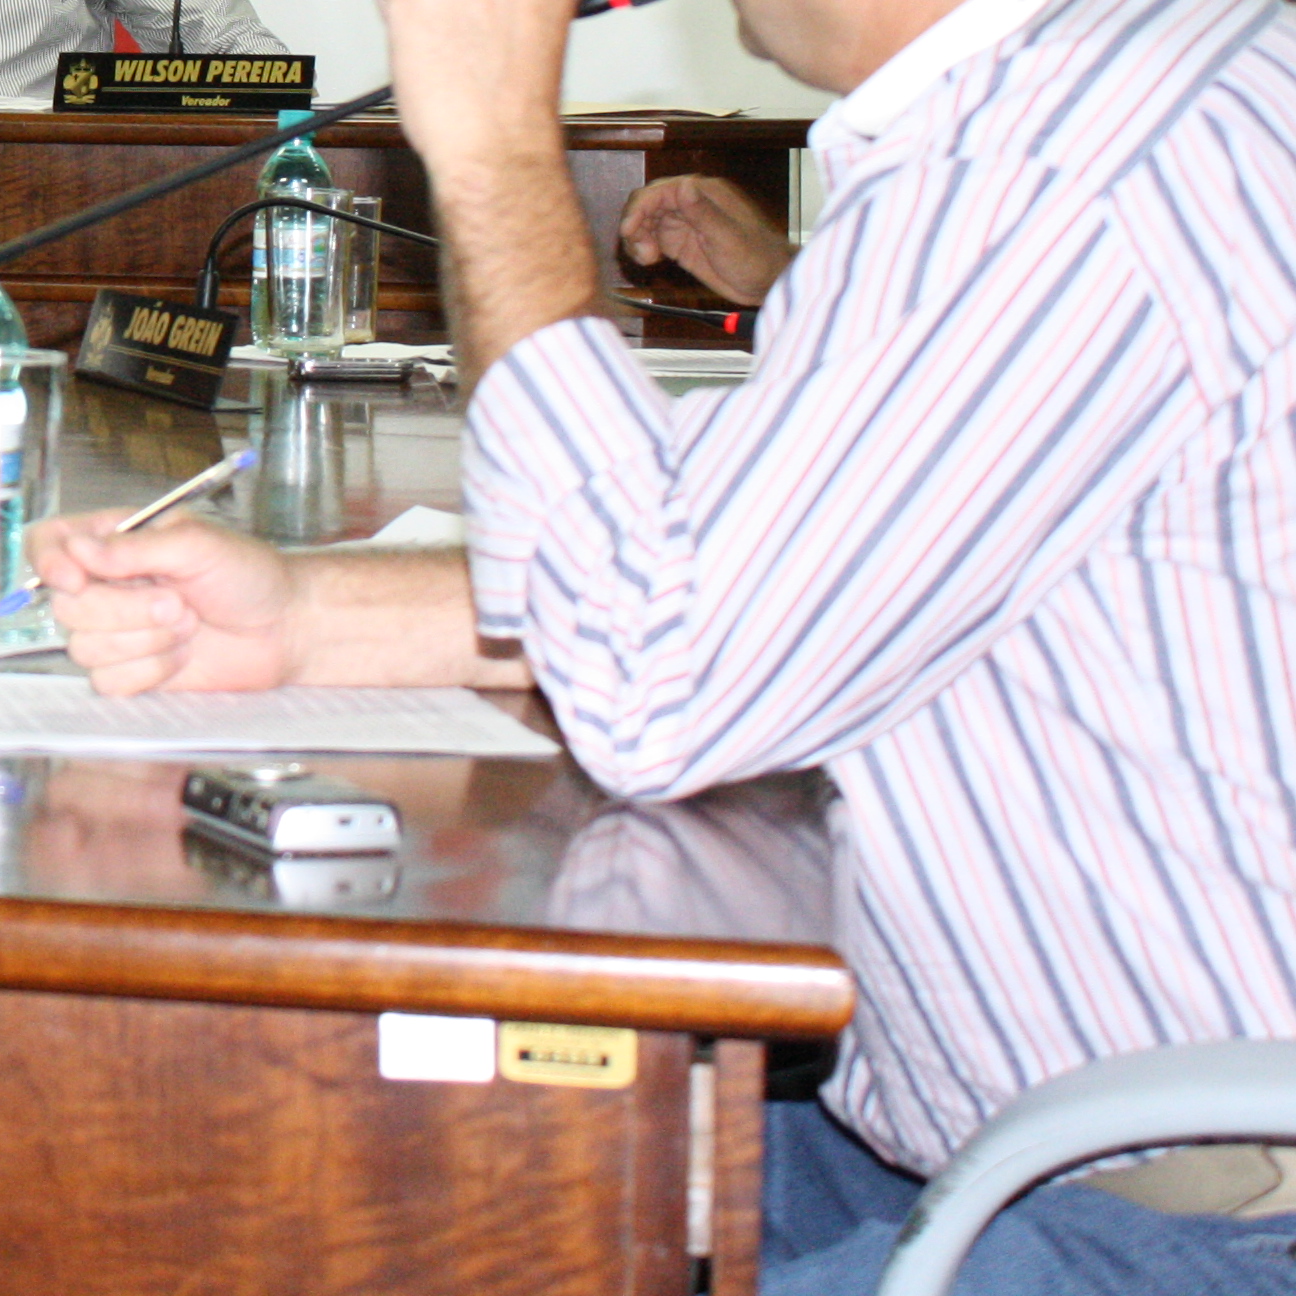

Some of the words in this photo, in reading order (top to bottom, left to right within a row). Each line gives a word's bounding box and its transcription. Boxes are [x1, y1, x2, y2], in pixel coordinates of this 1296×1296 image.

[114, 60, 202, 83] WILSON
[205, 60, 302, 84] PEREIRA
[181, 95, 231, 107] Vereador
[167, 314, 224, 357] GREIN
